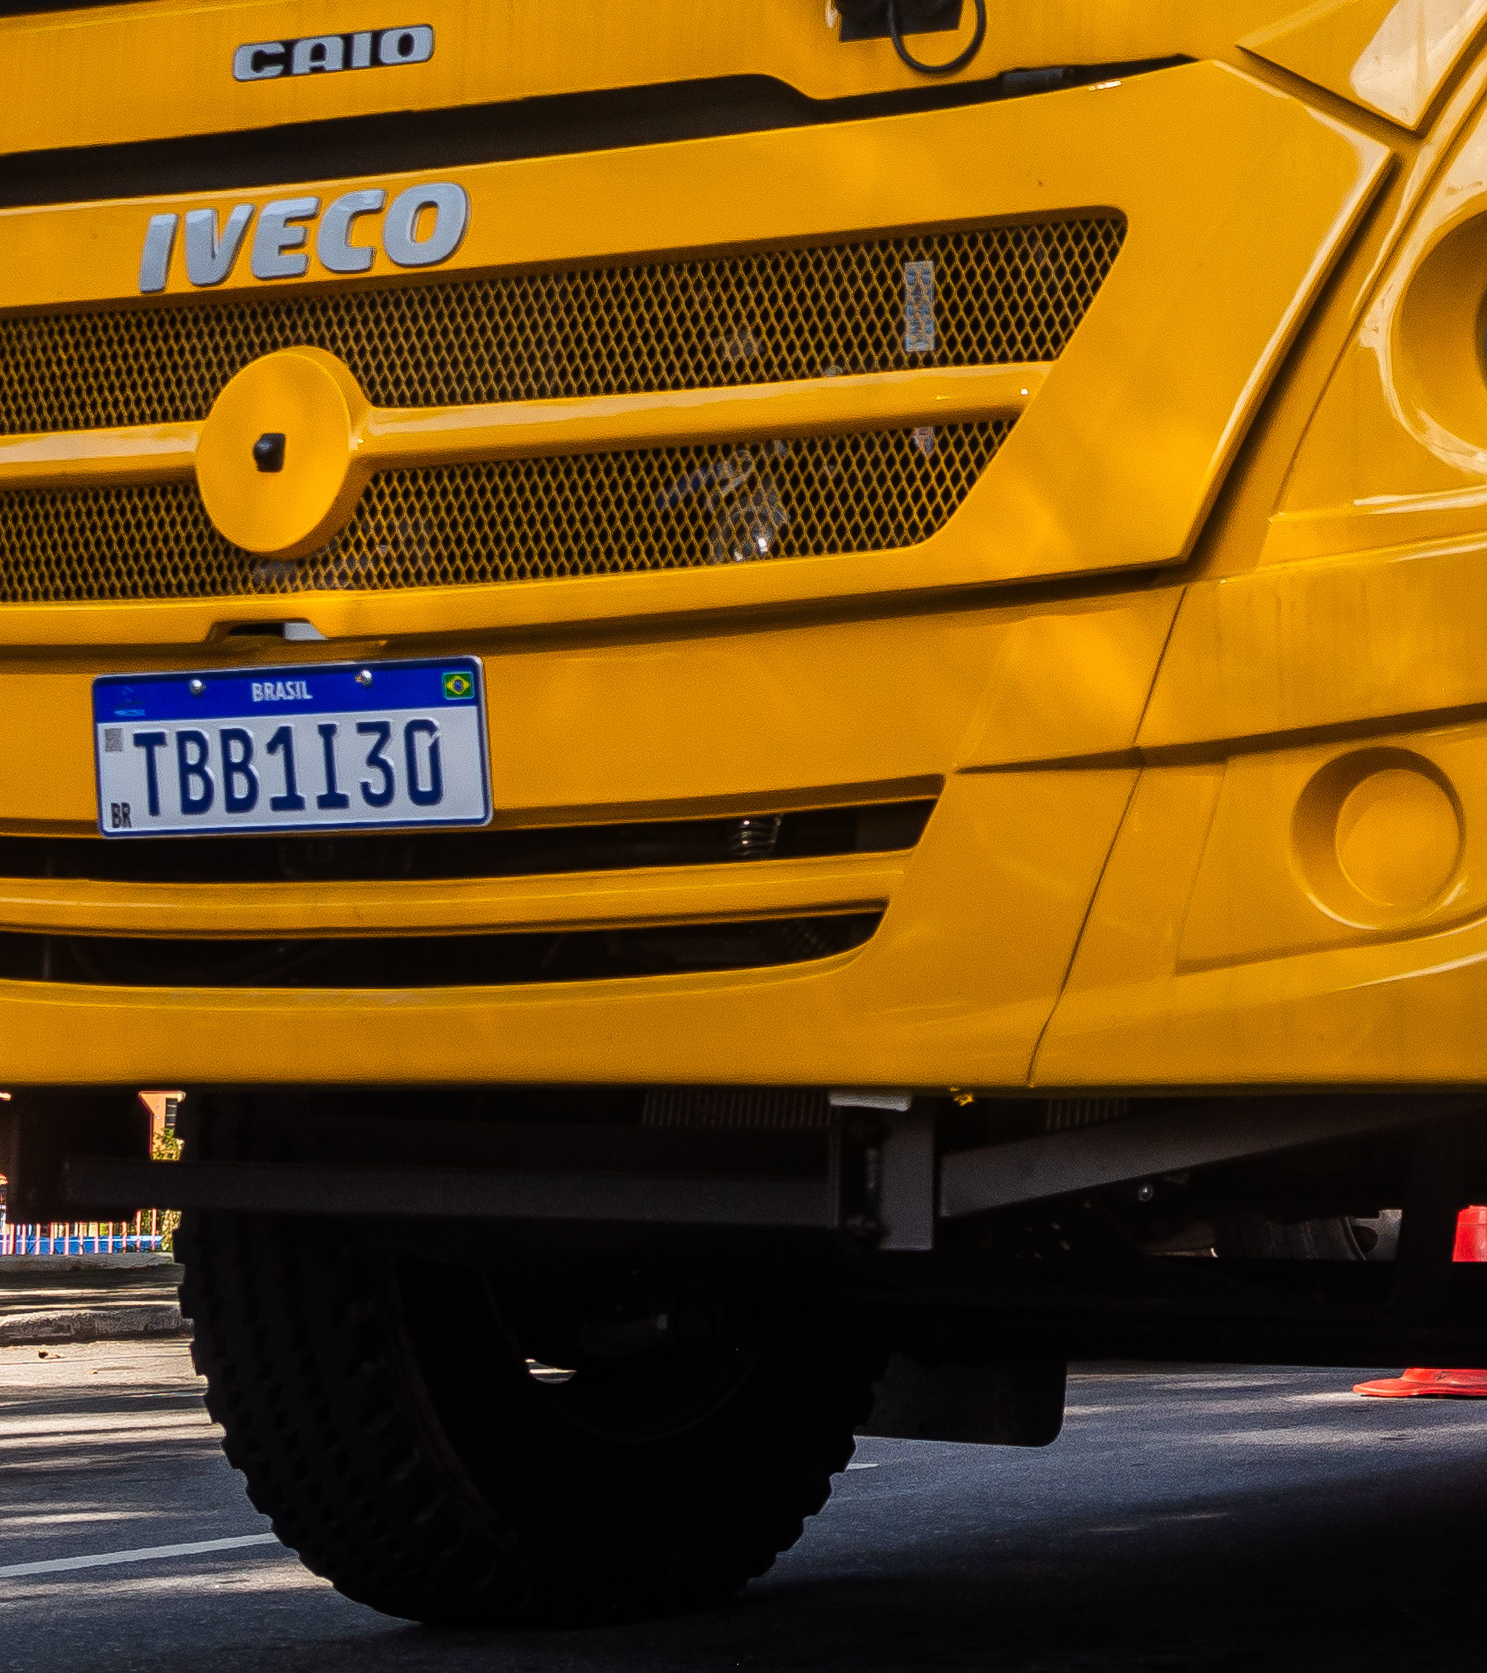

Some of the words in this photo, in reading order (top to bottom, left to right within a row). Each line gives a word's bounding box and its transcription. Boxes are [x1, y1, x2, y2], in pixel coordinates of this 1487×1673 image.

[232, 24, 435, 83] CAIO
[138, 181, 471, 294] IVECO
[250, 679, 313, 702] BRASIL
[132, 718, 444, 818] TBB1I30
[110, 801, 132, 829] BR
